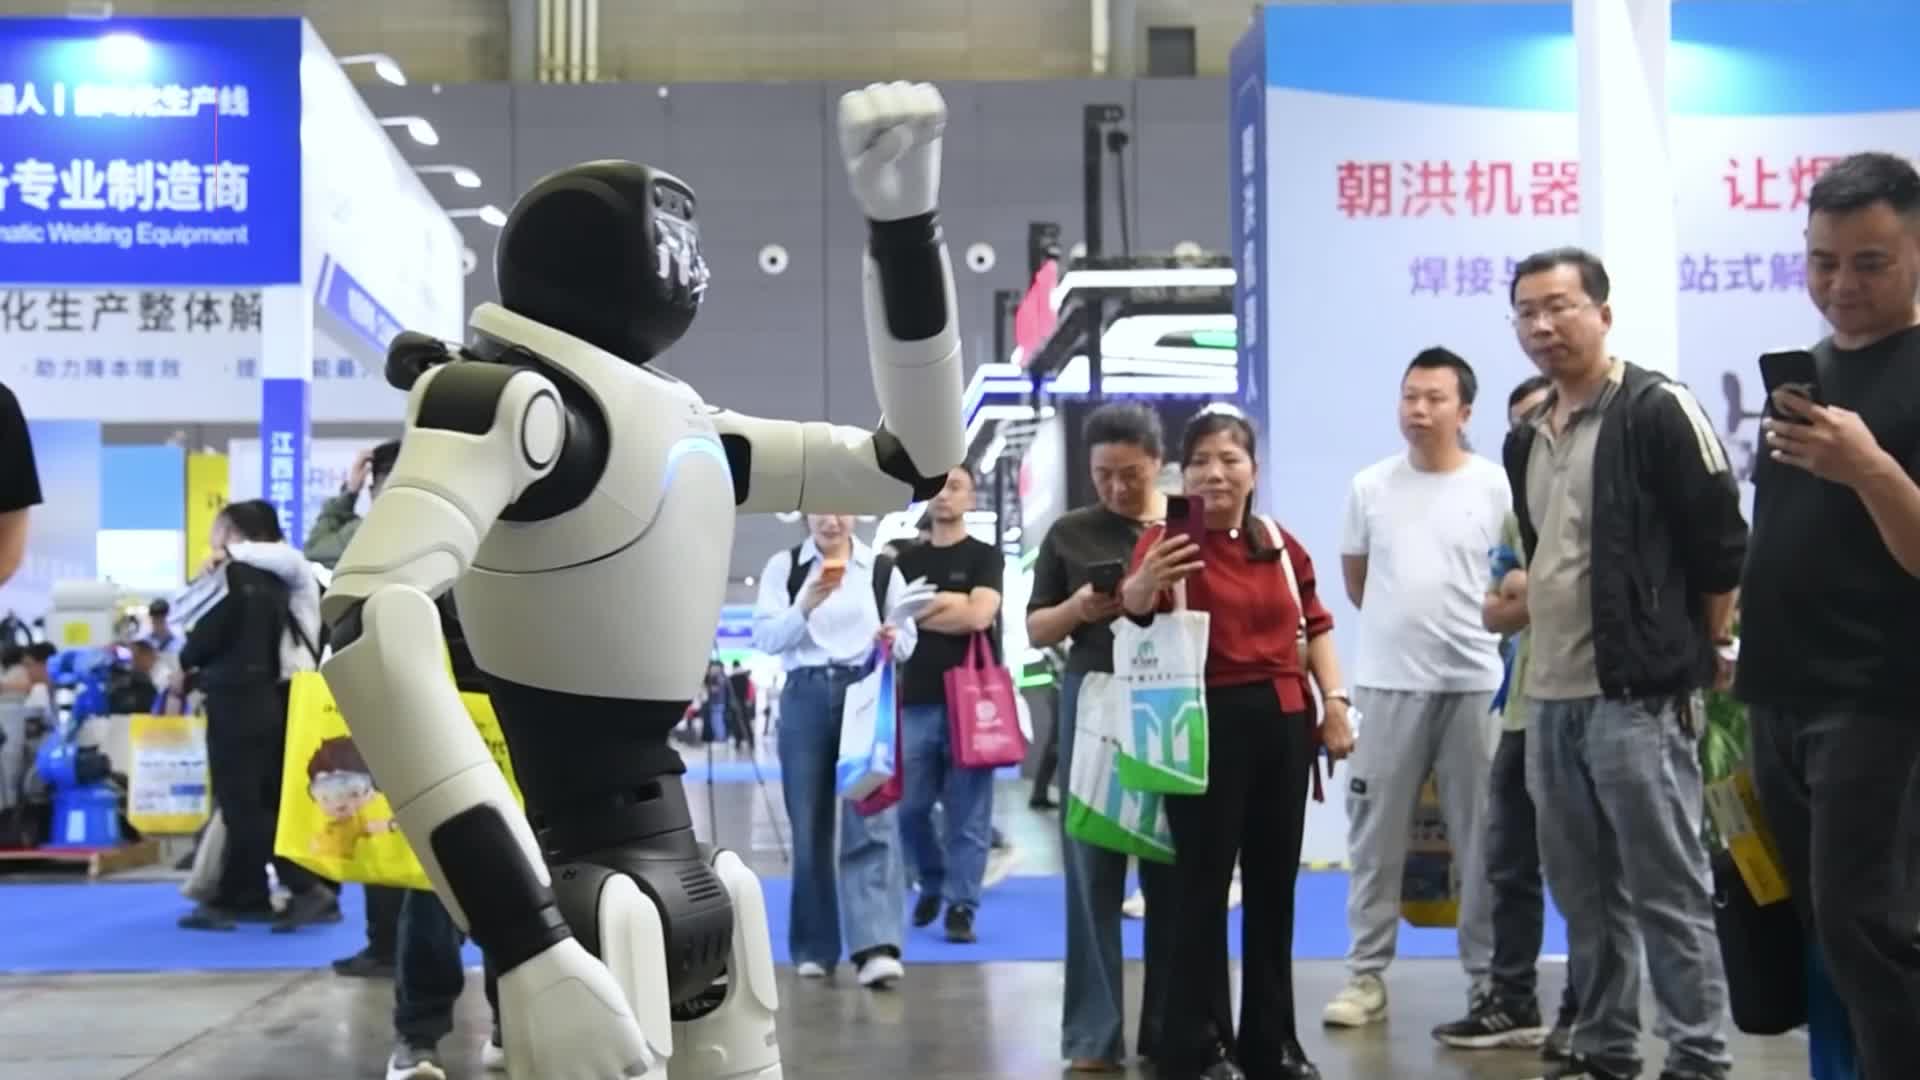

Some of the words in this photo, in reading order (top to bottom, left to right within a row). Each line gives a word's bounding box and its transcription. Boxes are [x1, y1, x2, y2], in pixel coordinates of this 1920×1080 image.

[0, 158, 249, 212] 专业制造商
[1336, 160, 1579, 217] 朝洪机器
[47, 221, 133, 248] Welding
[136, 221, 249, 248] Equipment
[2, 290, 262, 333] 化生产整体解
